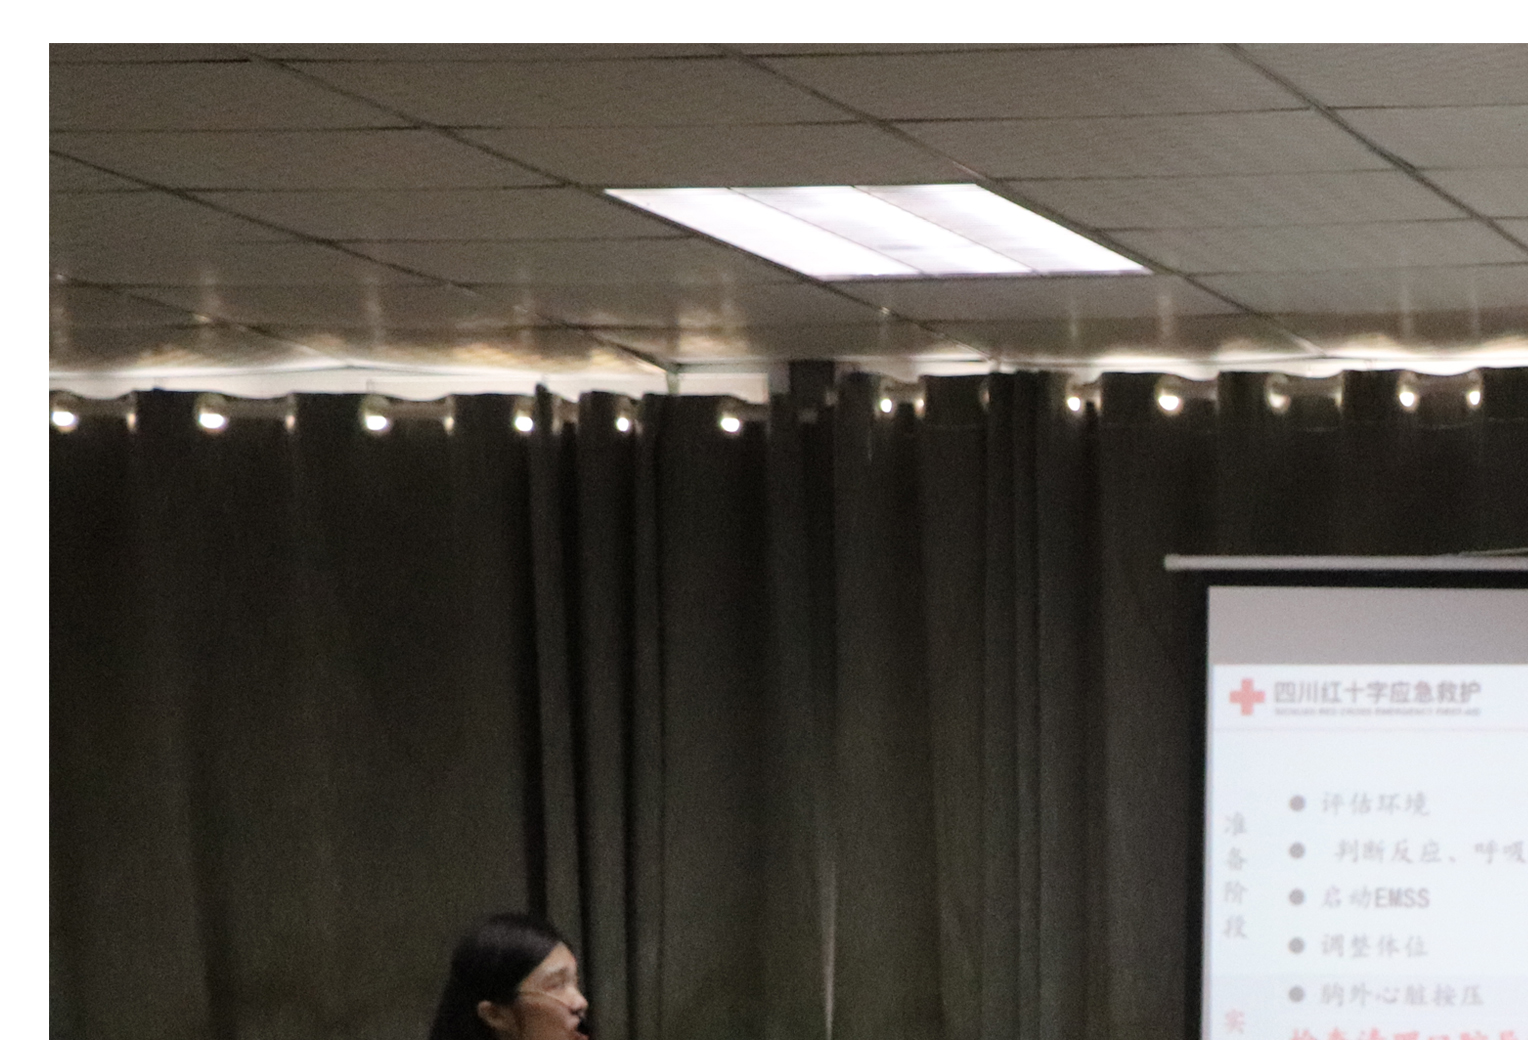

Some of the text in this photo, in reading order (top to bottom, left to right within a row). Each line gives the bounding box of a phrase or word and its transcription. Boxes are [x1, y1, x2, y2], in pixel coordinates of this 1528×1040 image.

[1274, 680, 1482, 704] 四川红十字应急救护
[1321, 790, 1431, 818] 评估环境
[1334, 837, 1528, 865] 判断反应、呼吸
[1222, 811, 1249, 941] 准备阶段
[1321, 885, 1432, 911] 启动EMSS
[1320, 933, 1429, 960] 调整体位
[1320, 982, 1485, 1008] 胸外心脏按压
